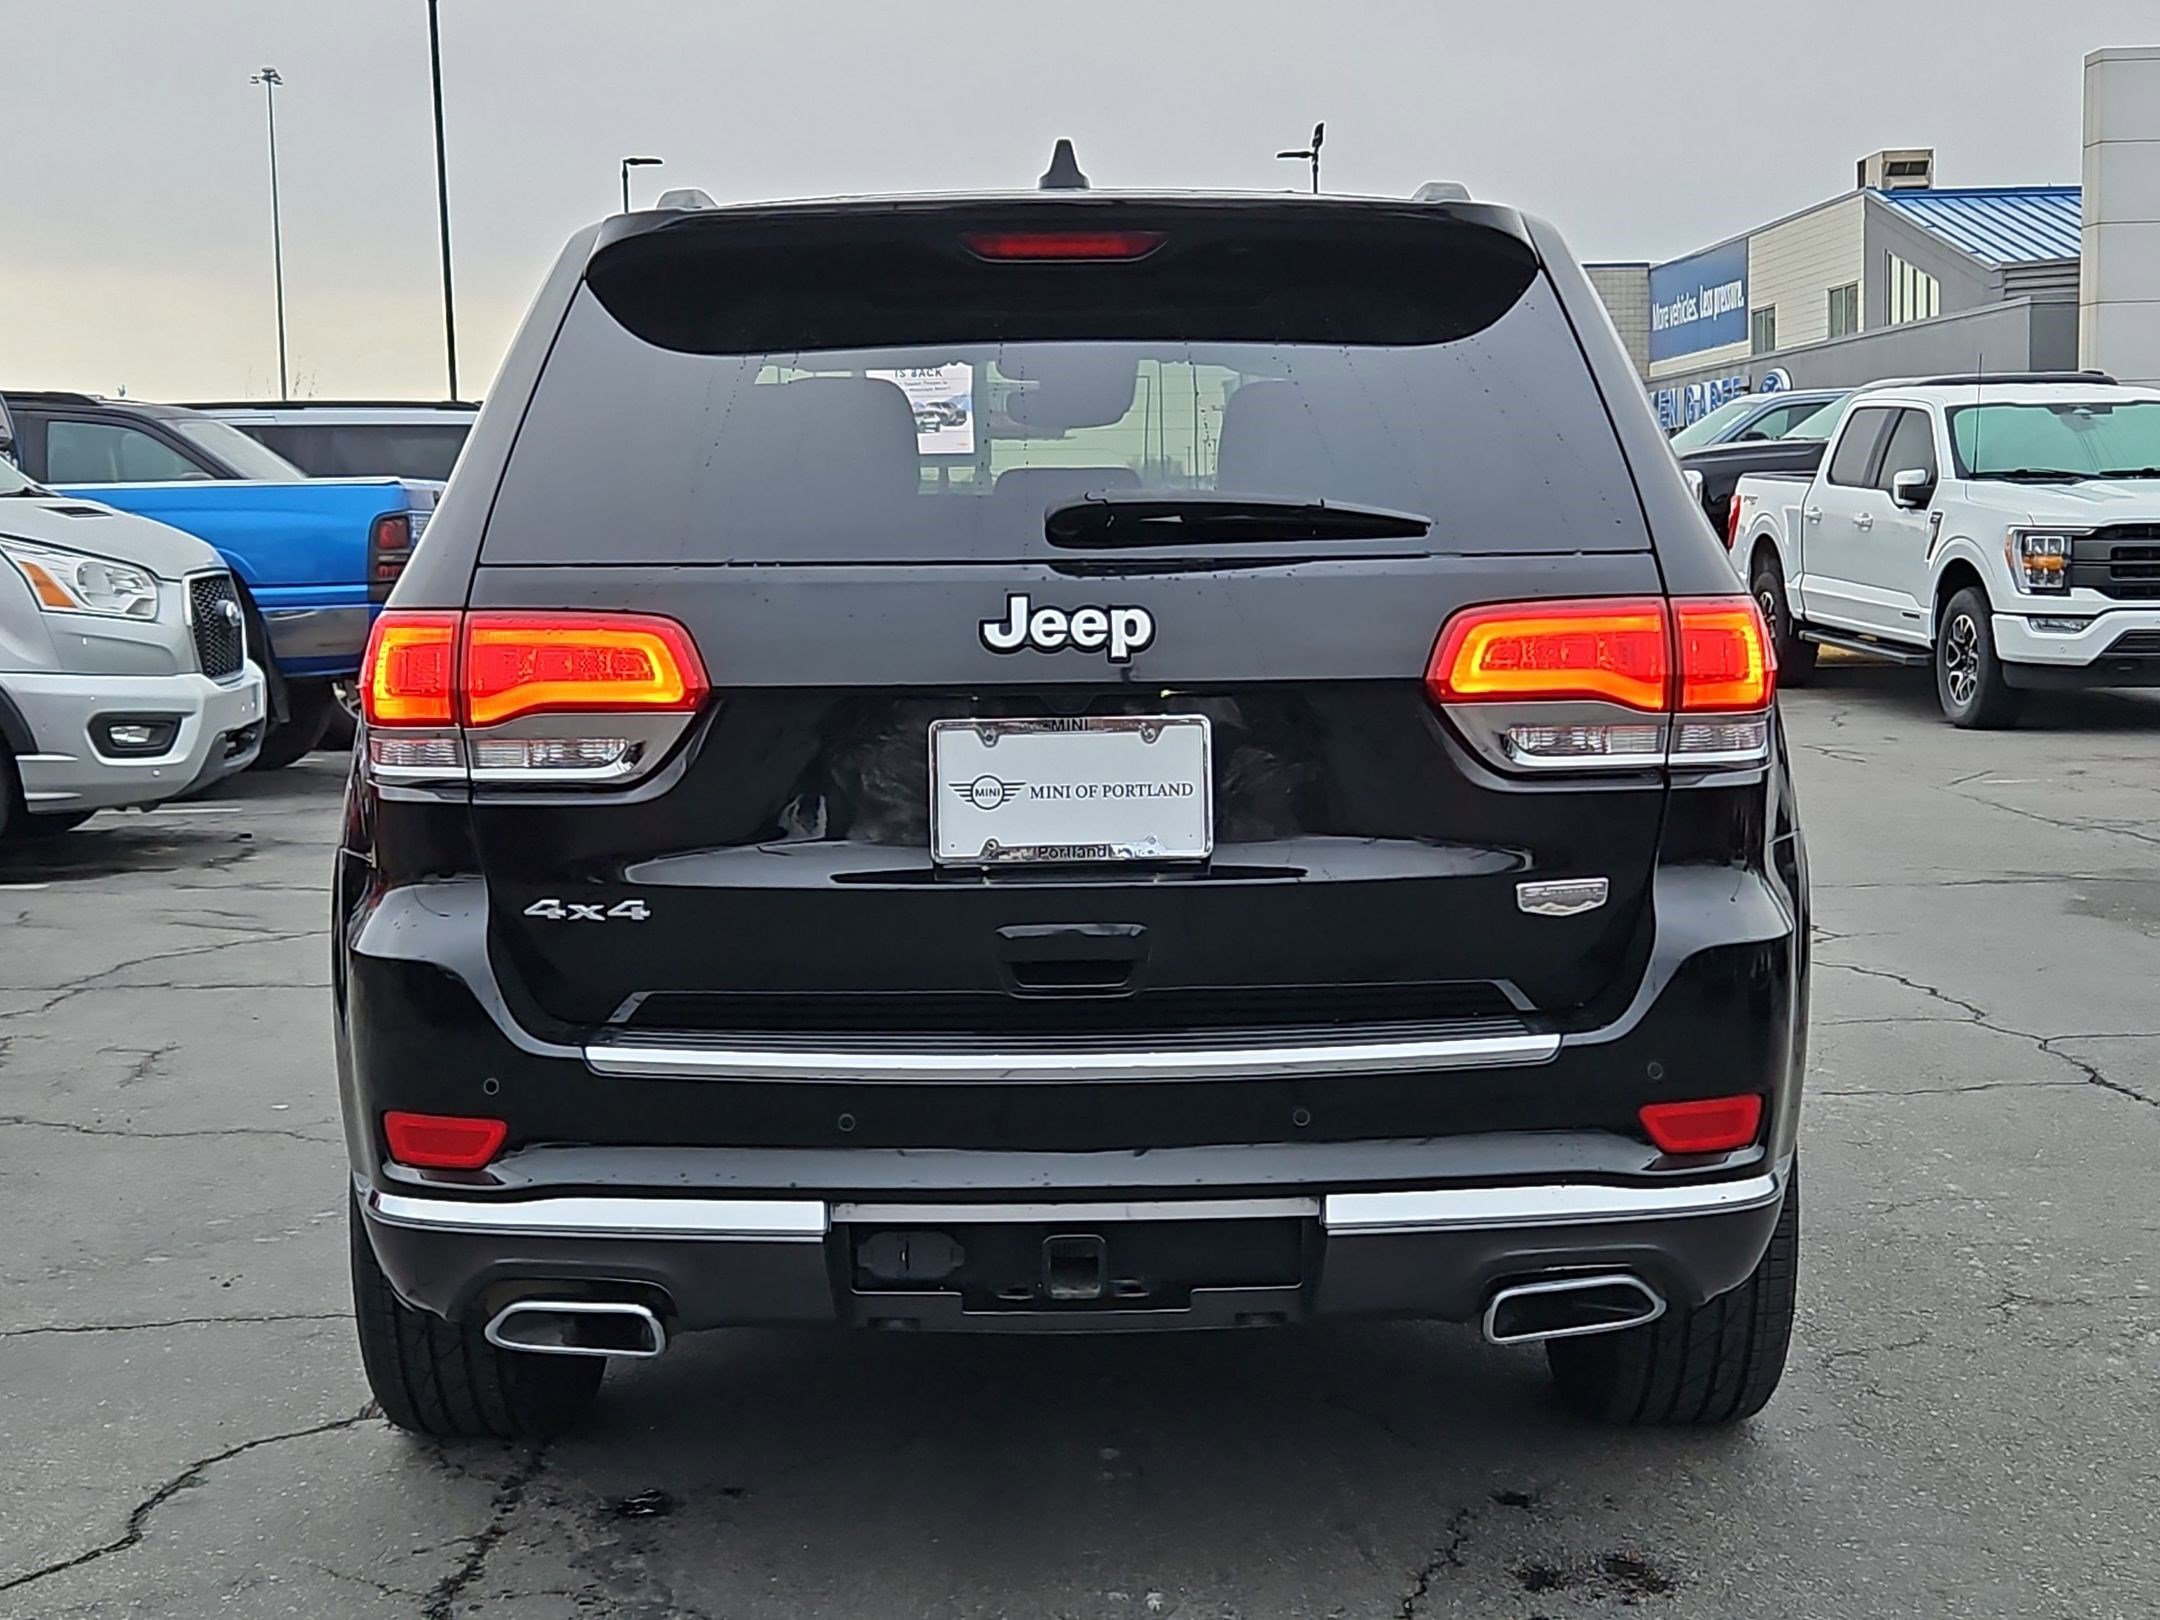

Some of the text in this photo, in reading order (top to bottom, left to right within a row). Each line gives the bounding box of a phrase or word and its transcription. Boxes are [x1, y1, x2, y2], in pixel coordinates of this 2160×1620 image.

[1652, 302, 1669, 332] More
[1699, 284, 1713, 319] Less
[981, 594, 1153, 660] Jeep
[1050, 718, 1090, 733] MINI
[975, 788, 1001, 798] MINI
[1029, 782, 1194, 799] MINI OF PORTLAND
[1037, 845, 1108, 860] Portland
[523, 899, 651, 921] 4x4
